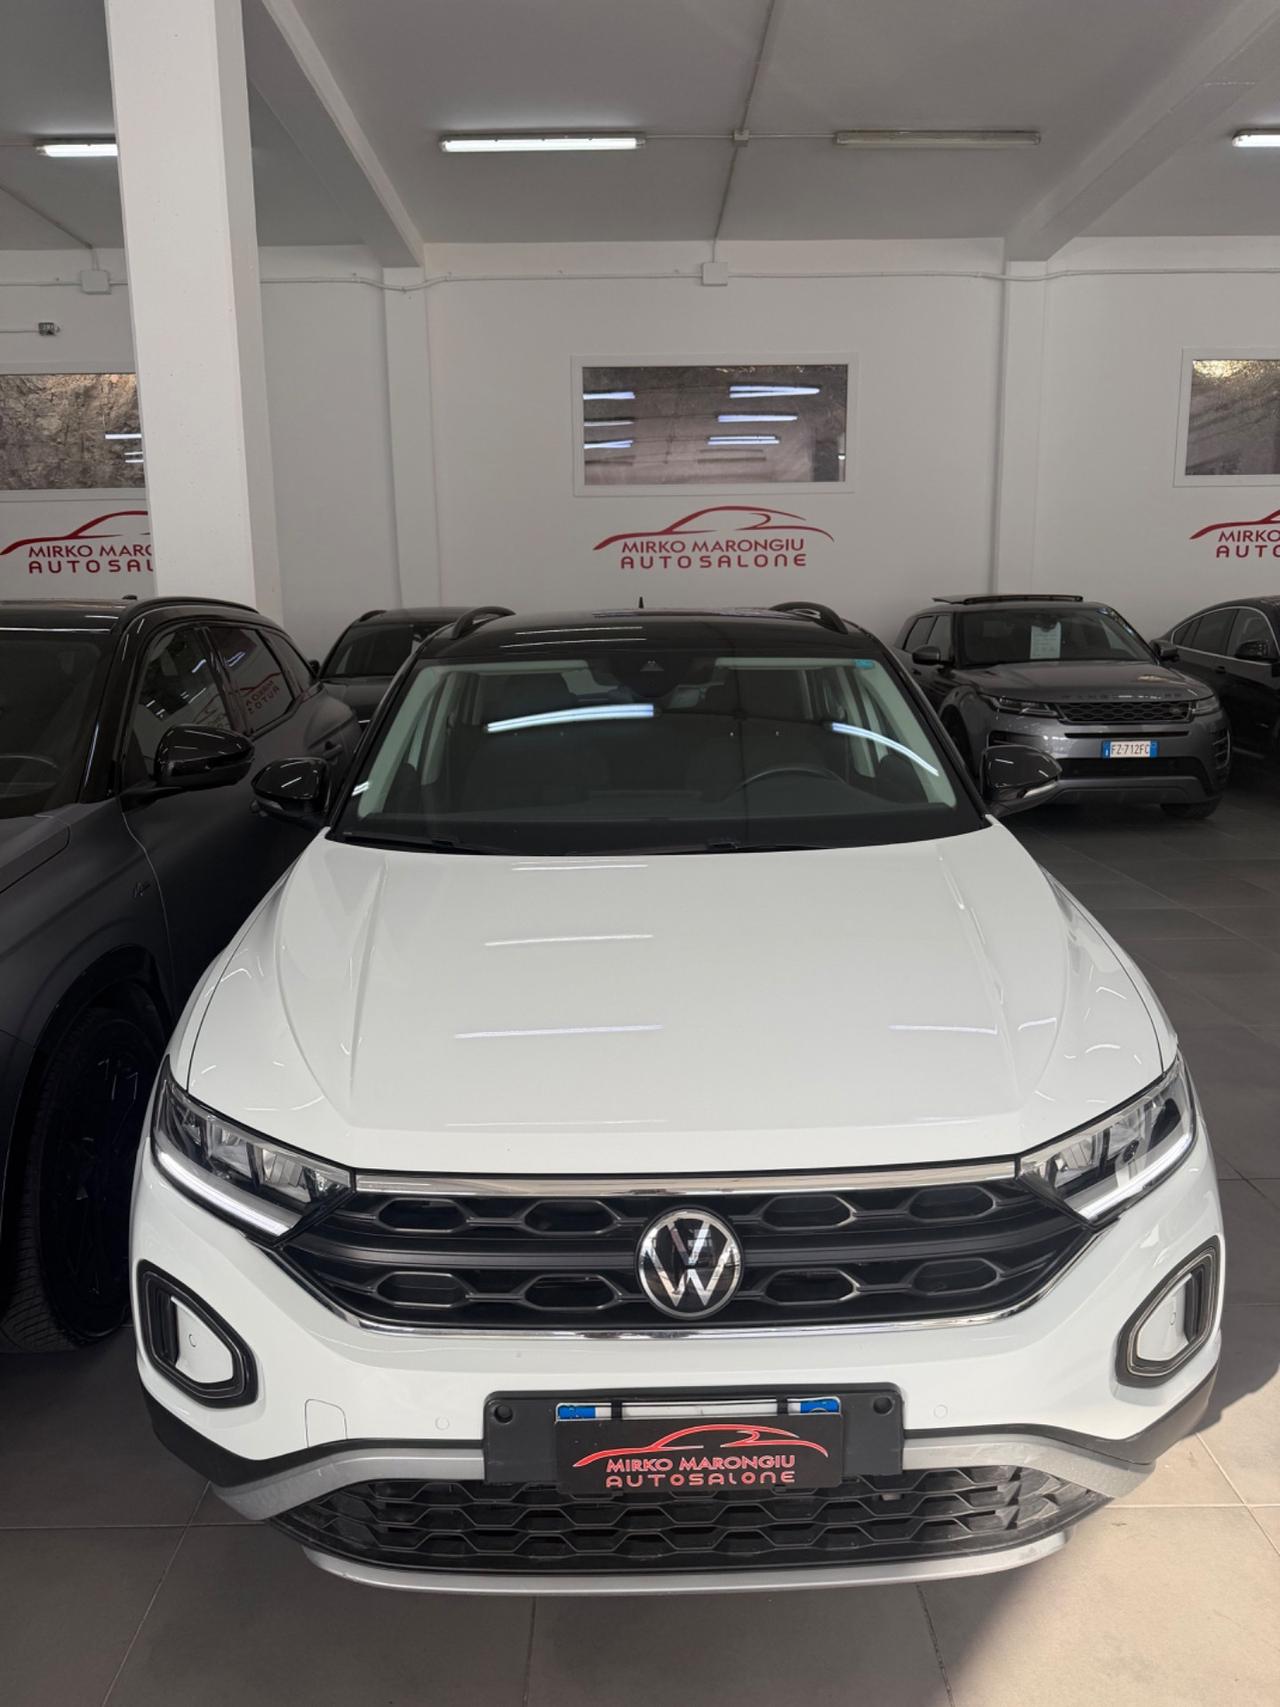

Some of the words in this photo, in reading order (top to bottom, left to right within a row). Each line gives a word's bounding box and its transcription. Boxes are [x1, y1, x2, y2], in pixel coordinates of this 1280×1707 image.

[1218, 529, 1280, 543] MIRKO
[28, 544, 93, 558] MIRKO
[621, 540, 686, 554] MIRKO
[691, 538, 805, 553] MARONGIU
[620, 553, 807, 570] AUTOSALONE
[606, 1457, 674, 1473] MIRKO
[678, 1454, 796, 1471] MARONGIU
[605, 1470, 796, 1488] AUTOSALONE
